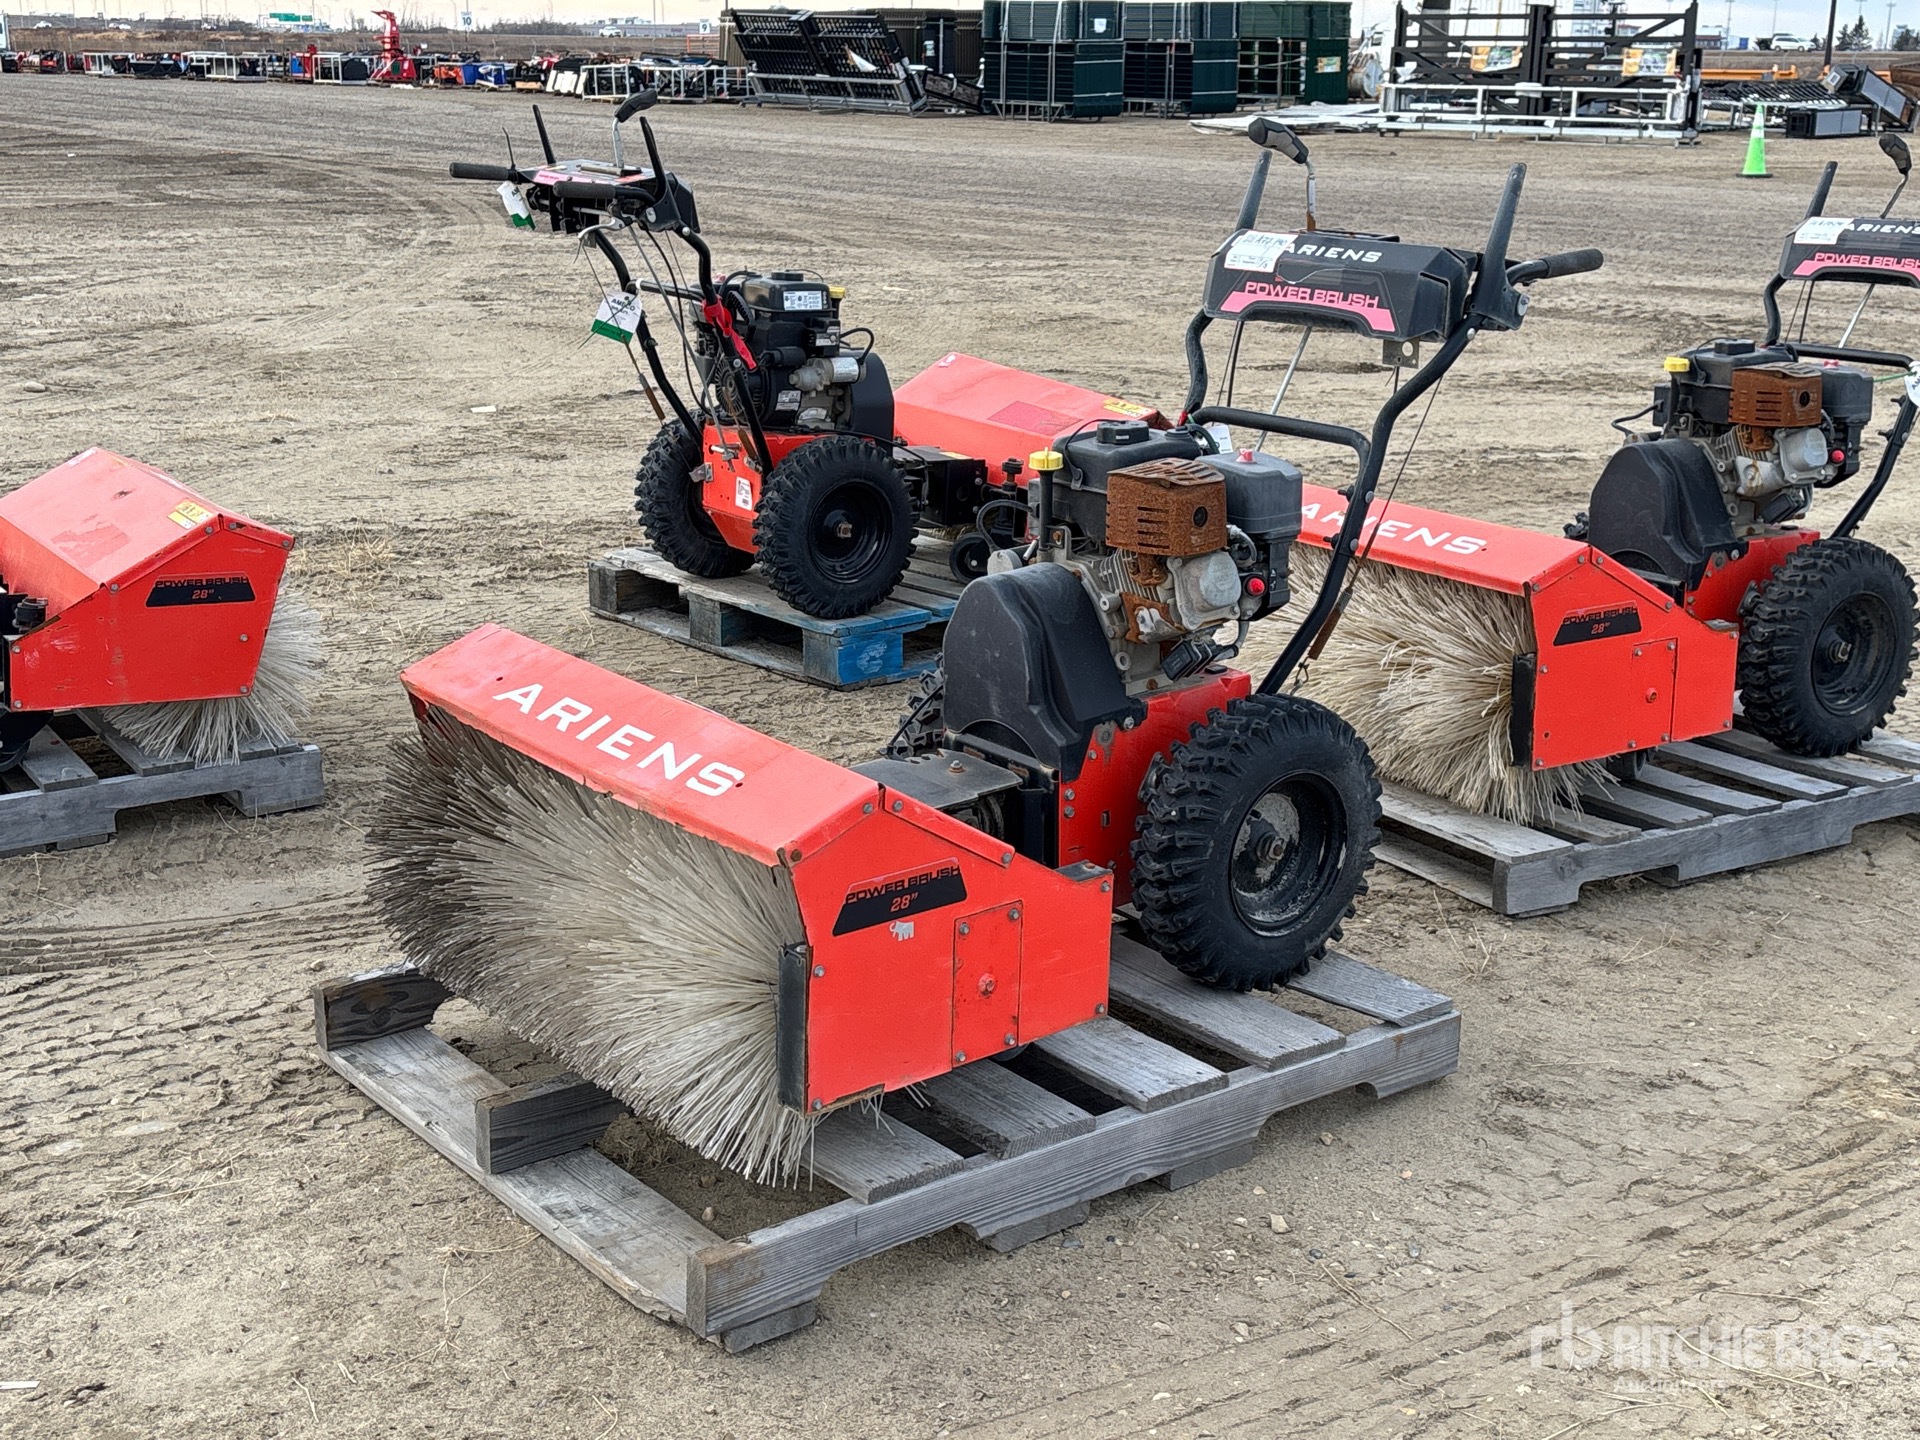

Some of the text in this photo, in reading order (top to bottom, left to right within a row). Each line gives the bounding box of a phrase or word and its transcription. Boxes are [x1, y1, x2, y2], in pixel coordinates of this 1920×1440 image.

[462, 16, 472, 26] 10
[702, 23, 708, 32] 9
[1815, 252, 1870, 266] POWER
[1245, 281, 1379, 309] POWER BRUSH
[155, 576, 250, 588] POWER BRUSH
[1563, 611, 1602, 625] POWER
[492, 683, 746, 797] ARIENS
[845, 865, 960, 904] POWER BRUSH
